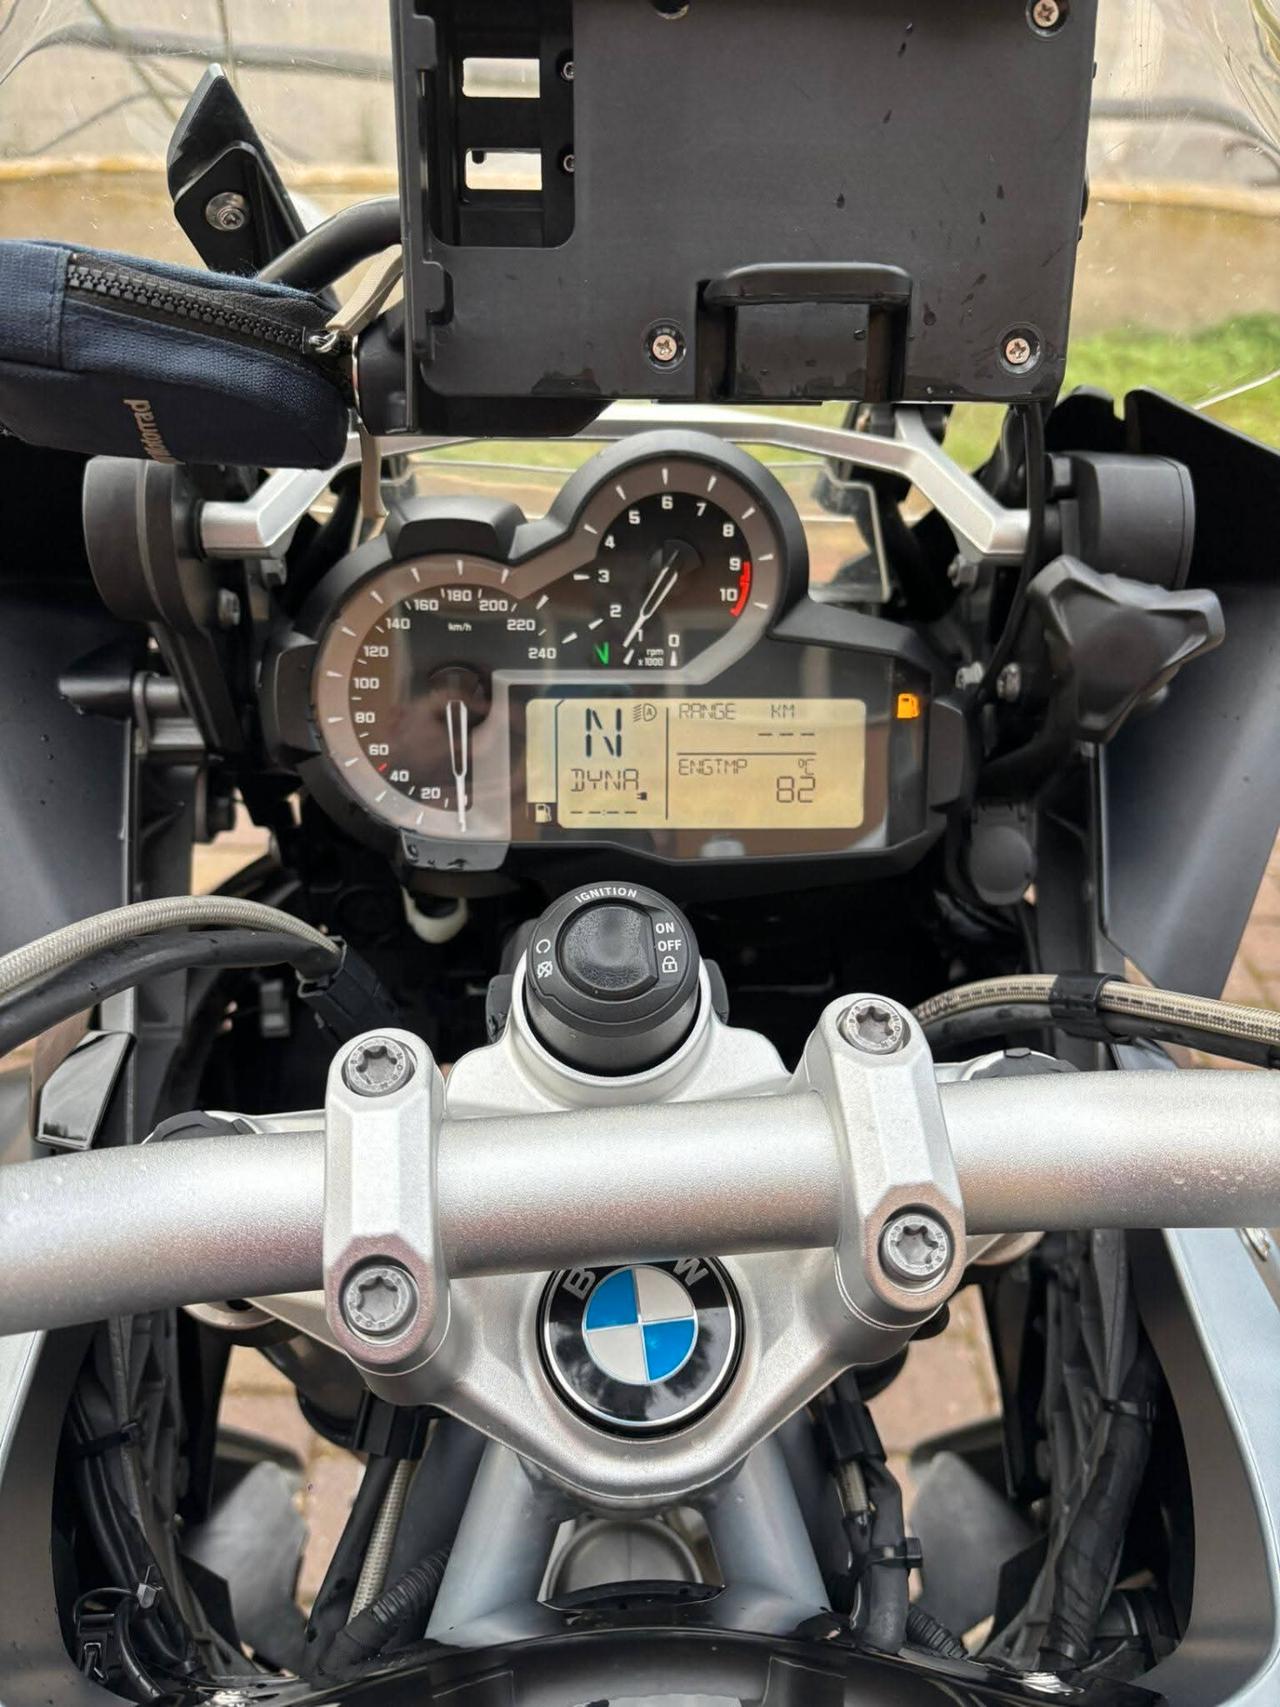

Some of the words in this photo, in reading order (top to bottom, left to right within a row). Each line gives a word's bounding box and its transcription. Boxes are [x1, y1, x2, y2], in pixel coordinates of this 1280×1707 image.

[662, 496, 673, 510] 6
[696, 503, 706, 517] 7
[629, 510, 640, 524] 5
[723, 524, 734, 537] 8
[604, 536, 616, 549] 4
[729, 558, 741, 571] 9
[598, 570, 610, 583] 3
[447, 590, 472, 602] 180
[720, 588, 738, 602] 10
[414, 600, 439, 611] 160
[479, 601, 508, 612] 200
[610, 604, 621, 618] 2
[386, 619, 410, 630] 140
[448, 622, 472, 632] km/h
[507, 620, 536, 631] 220
[668, 634, 680, 648] 0
[364, 646, 389, 657] 120
[528, 648, 557, 660] 240
[646, 648, 664, 656] rpm
[353, 678, 380, 689] 100
[355, 712, 376, 724] 80
[678, 703, 736, 720] RANGE
[771, 704, 796, 719] KM
[585, 708, 623, 758] N
[369, 744, 389, 756] 60
[678, 759, 748, 776] ENGTMP
[390, 770, 409, 782] 40
[570, 768, 640, 792] DYNA
[420, 787, 441, 799] 20
[776, 776, 816, 804] 82
[575, 887, 638, 903] IGNITION
[655, 922, 675, 934] ON
[657, 939, 682, 952] OFF
[562, 1256, 709, 1300] BW
